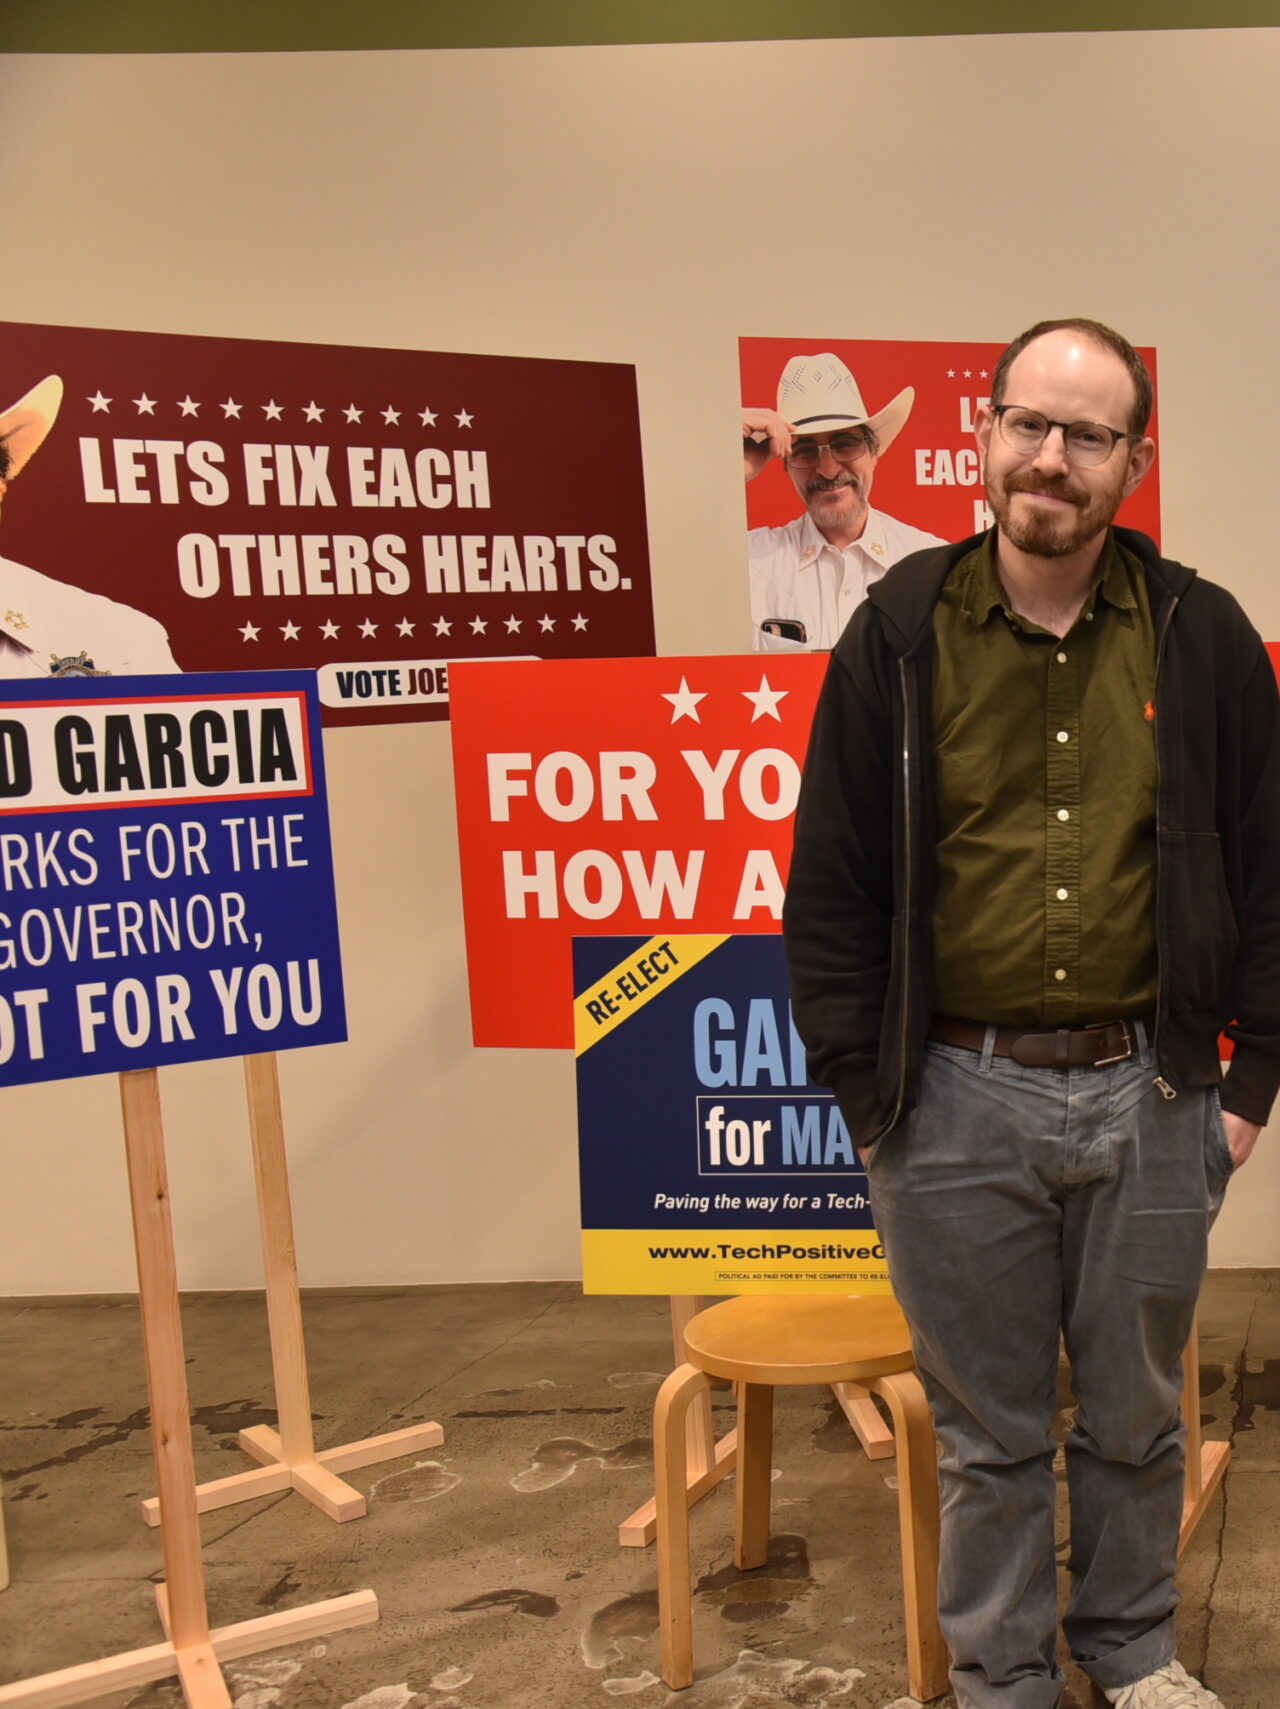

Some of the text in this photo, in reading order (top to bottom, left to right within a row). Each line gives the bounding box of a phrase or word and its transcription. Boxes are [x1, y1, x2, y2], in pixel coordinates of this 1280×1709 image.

[78, 436, 491, 509] LETS FIX EACH
[915, 449, 984, 486] EAC
[176, 532, 632, 598] OTHERS HEARTS.
[335, 667, 449, 698] VOTE JOE
[53, 708, 298, 796] GARCIA
[486, 750, 659, 823] FOR
[119, 822, 210, 881] FOR
[220, 813, 309, 872] THE
[502, 849, 705, 920] HOW
[76, 973, 196, 1054] FOR
[209, 958, 322, 1036] YOU
[585, 941, 679, 1025] RE-ELECT
[705, 1105, 771, 1166] for
[654, 1193, 871, 1213] Paving the way for a Tech-
